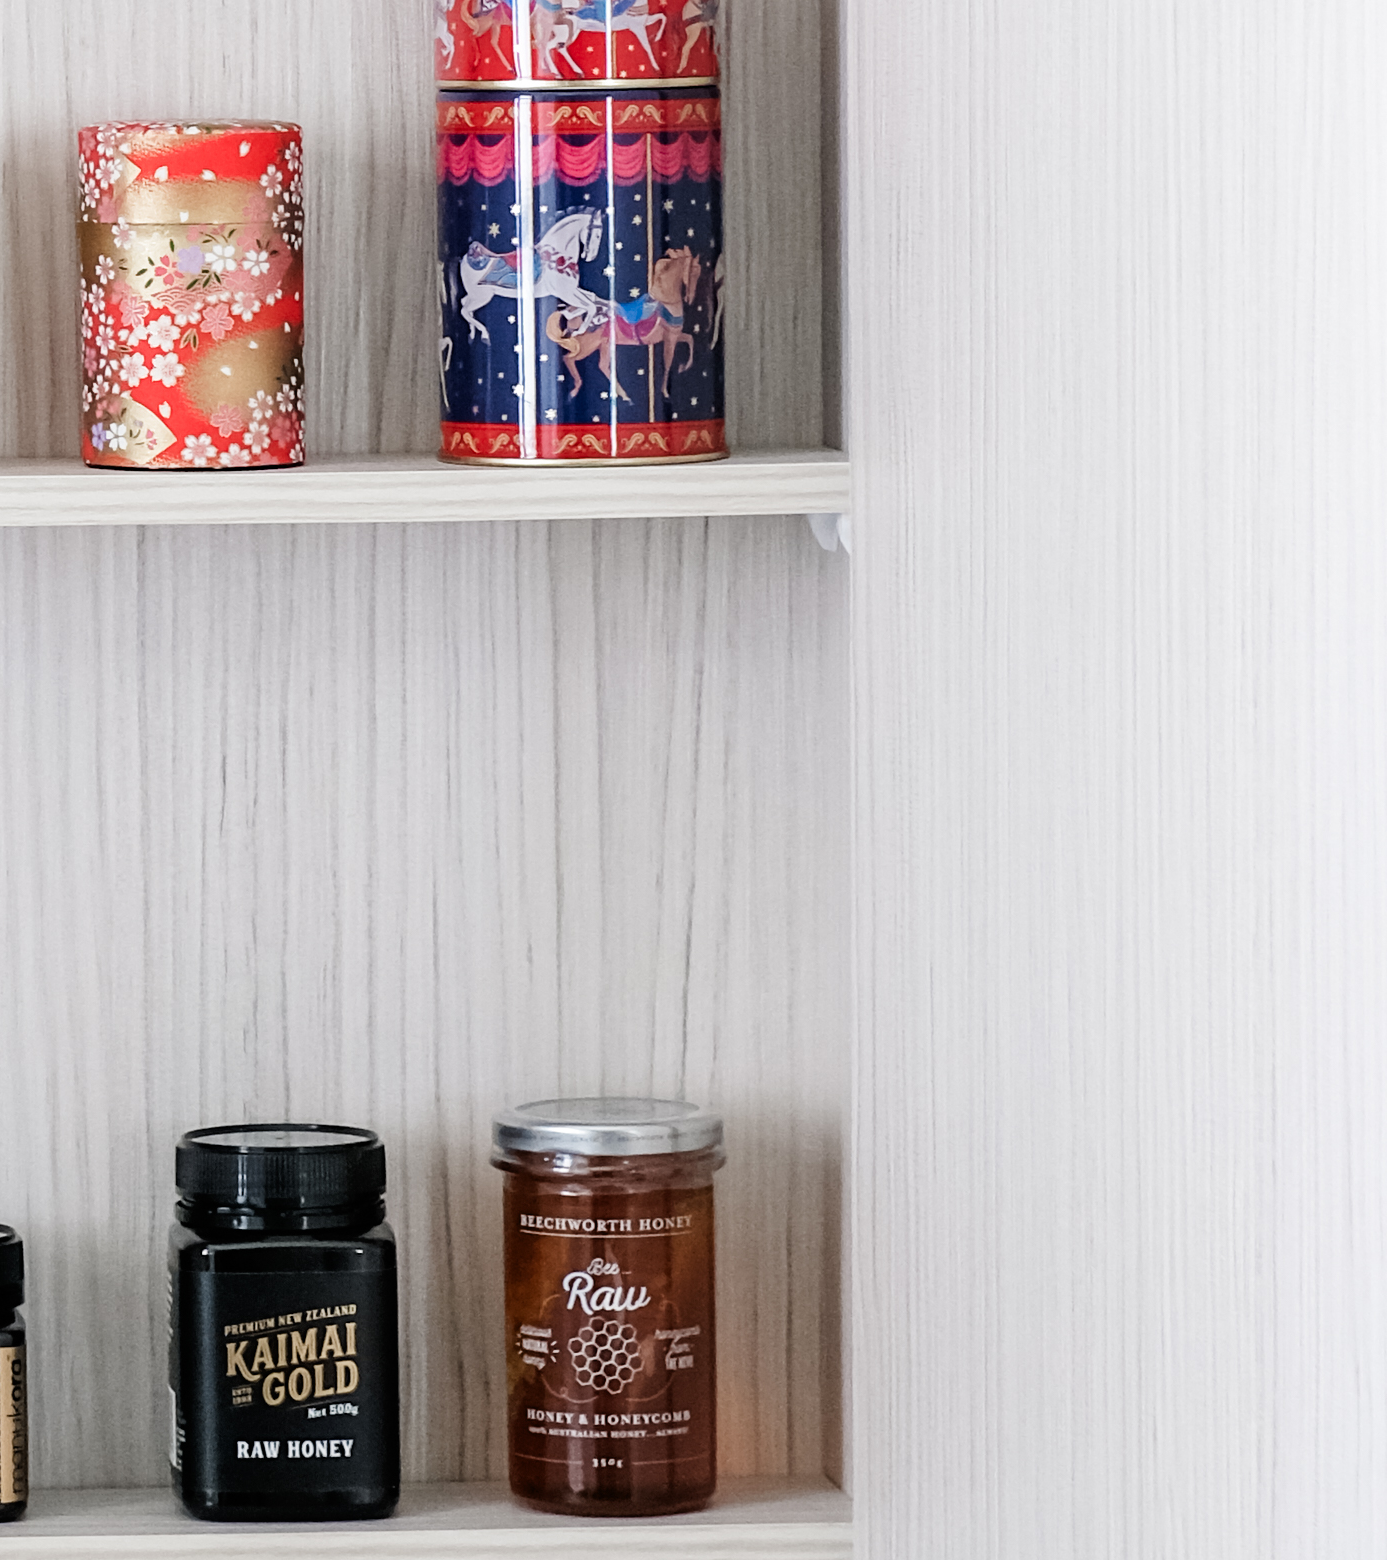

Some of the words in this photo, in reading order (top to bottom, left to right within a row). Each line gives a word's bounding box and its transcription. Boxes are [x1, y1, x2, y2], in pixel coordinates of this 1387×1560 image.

[520, 1214, 632, 1233] BEECHWORTH
[638, 1214, 692, 1231] HONEY
[586, 1257, 620, 1275] Bee
[562, 1270, 651, 1316] Raw
[224, 1316, 275, 1337] PREMIUM
[278, 1311, 303, 1326] NEW
[306, 1303, 357, 1321] ZEALAND
[225, 1321, 358, 1383] KAIMAI
[262, 1359, 359, 1407] GOLD
[307, 1406, 326, 1420] Net
[329, 1403, 359, 1417] 500g
[527, 1408, 574, 1424] HONEY
[593, 1409, 691, 1426] HONEYCOMB
[237, 1440, 280, 1459] RAW
[287, 1439, 354, 1459] HONEY
